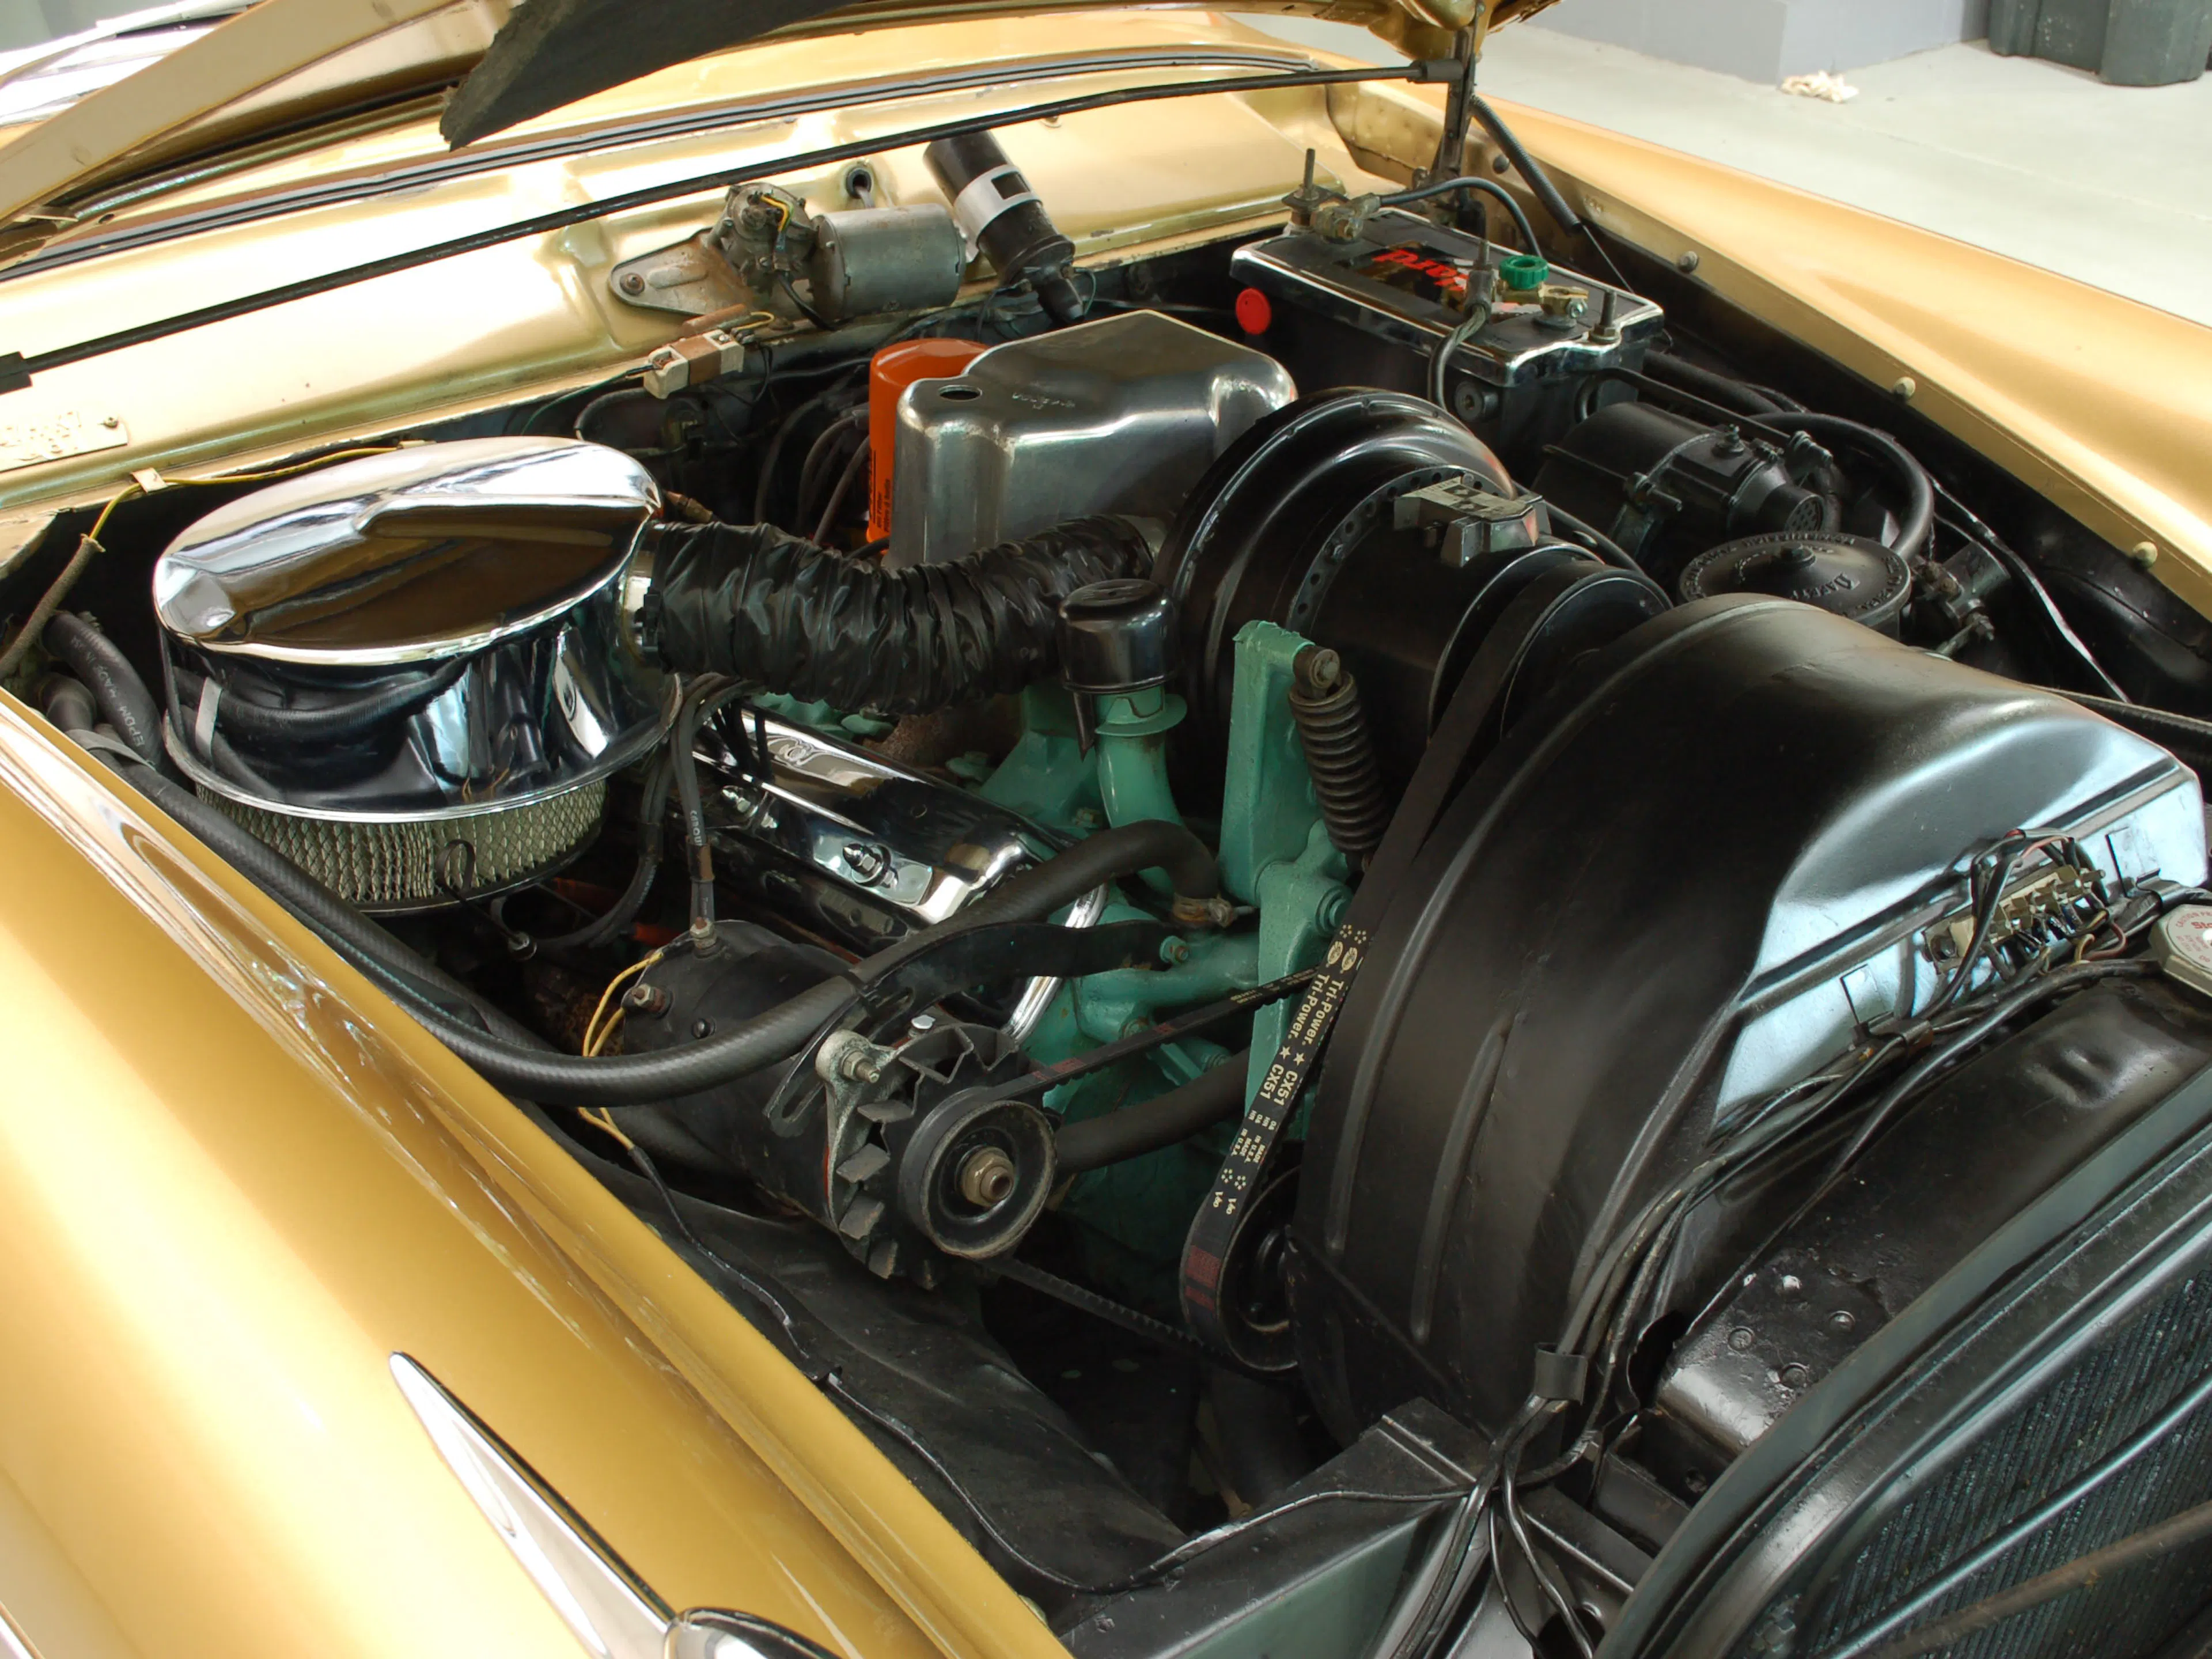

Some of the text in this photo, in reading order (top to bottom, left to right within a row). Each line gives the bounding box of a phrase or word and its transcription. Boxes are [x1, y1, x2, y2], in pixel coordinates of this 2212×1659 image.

[118, 706, 145, 747] EPDM
[1260, 1064, 1284, 1100] CX51
[1274, 1070, 1298, 1106] CX51
[1240, 1138, 1252, 1157] MADE
[1252, 1144, 1266, 1164] MADE
